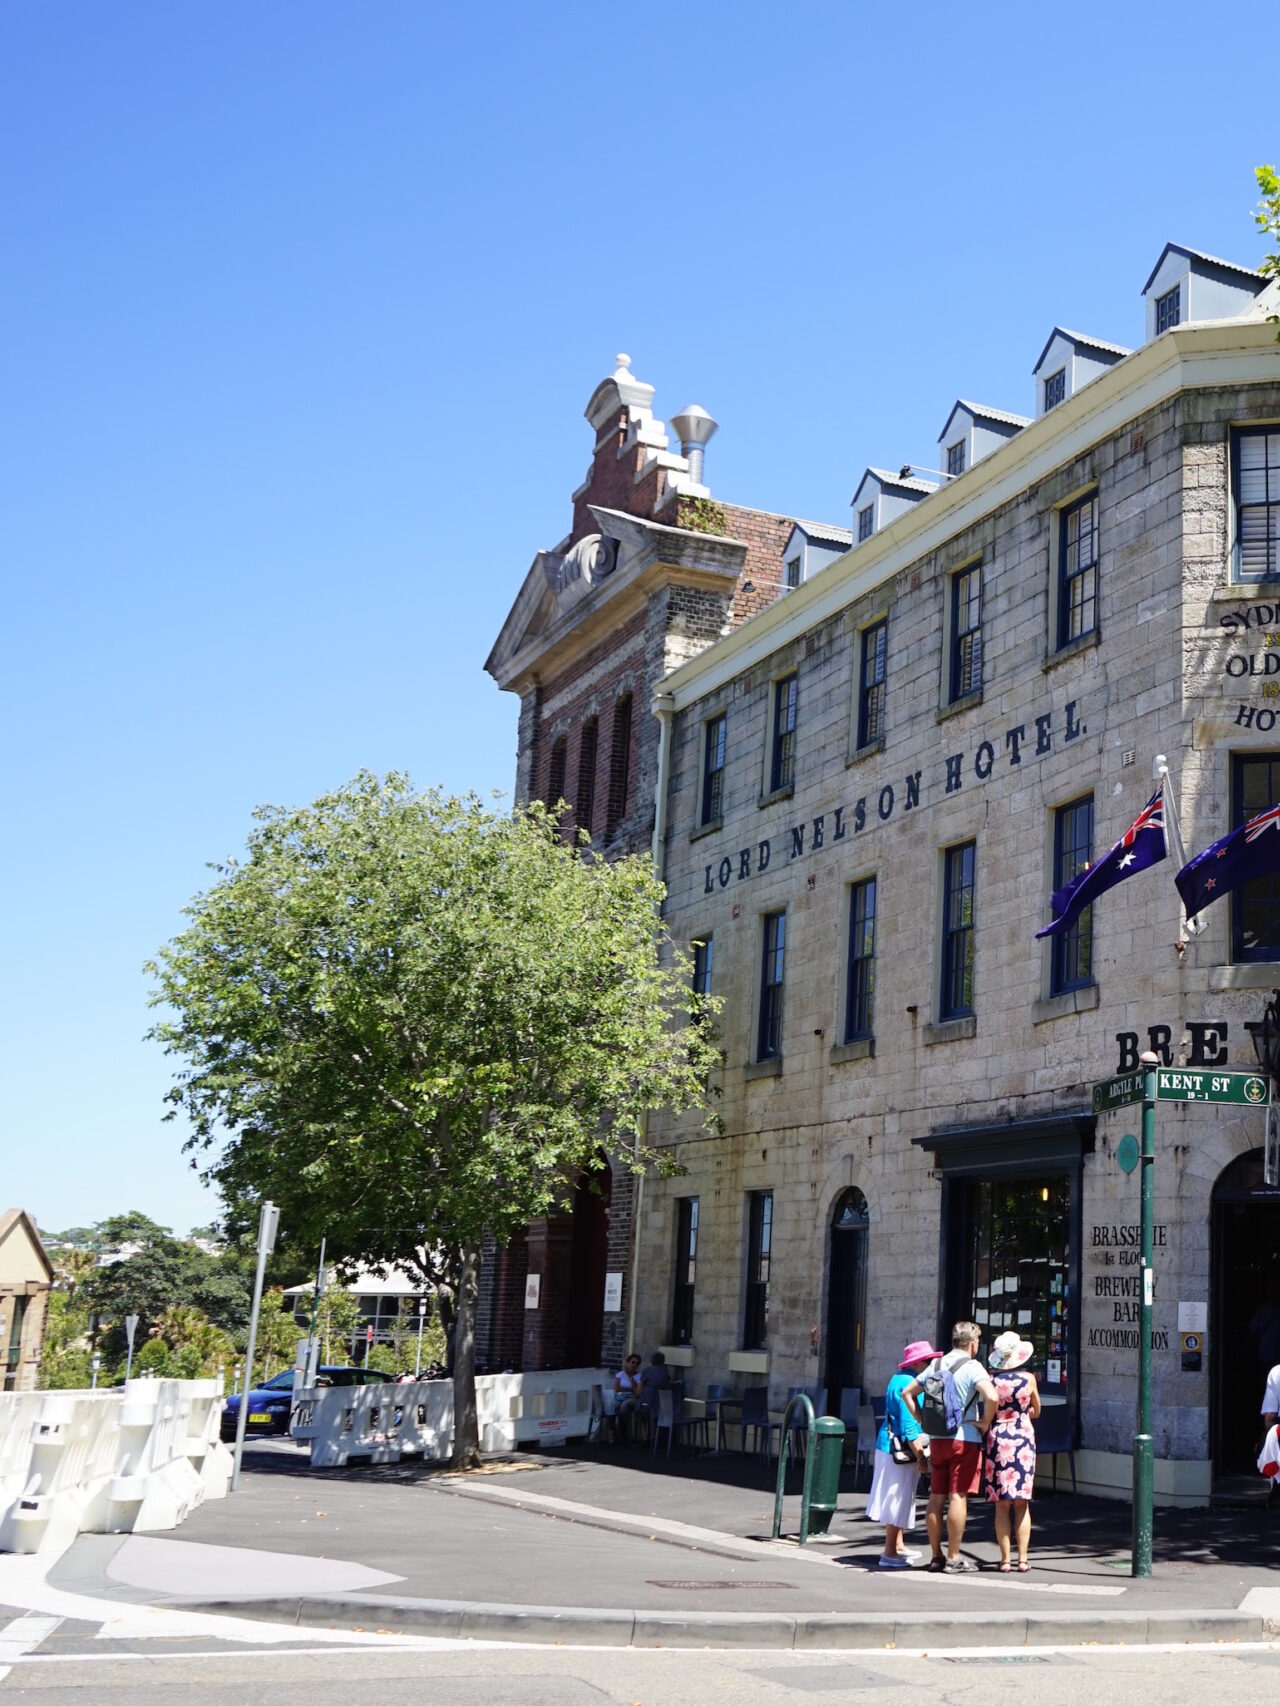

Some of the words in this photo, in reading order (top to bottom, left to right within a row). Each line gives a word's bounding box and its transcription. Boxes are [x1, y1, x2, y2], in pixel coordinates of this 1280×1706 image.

[704, 839, 771, 894] LORD
[791, 770, 922, 860] NELSON
[1160, 1073, 1204, 1091] KENT
[1211, 1077, 1230, 1093] ST
[1092, 1225, 1167, 1246] BRASSEIE
[1118, 1251, 1142, 1266] FLOO
[1095, 1276, 1158, 1298] BREWEY
[1113, 1302, 1140, 1322] BAR
[1087, 1328, 1169, 1350] ACCOMMODION
